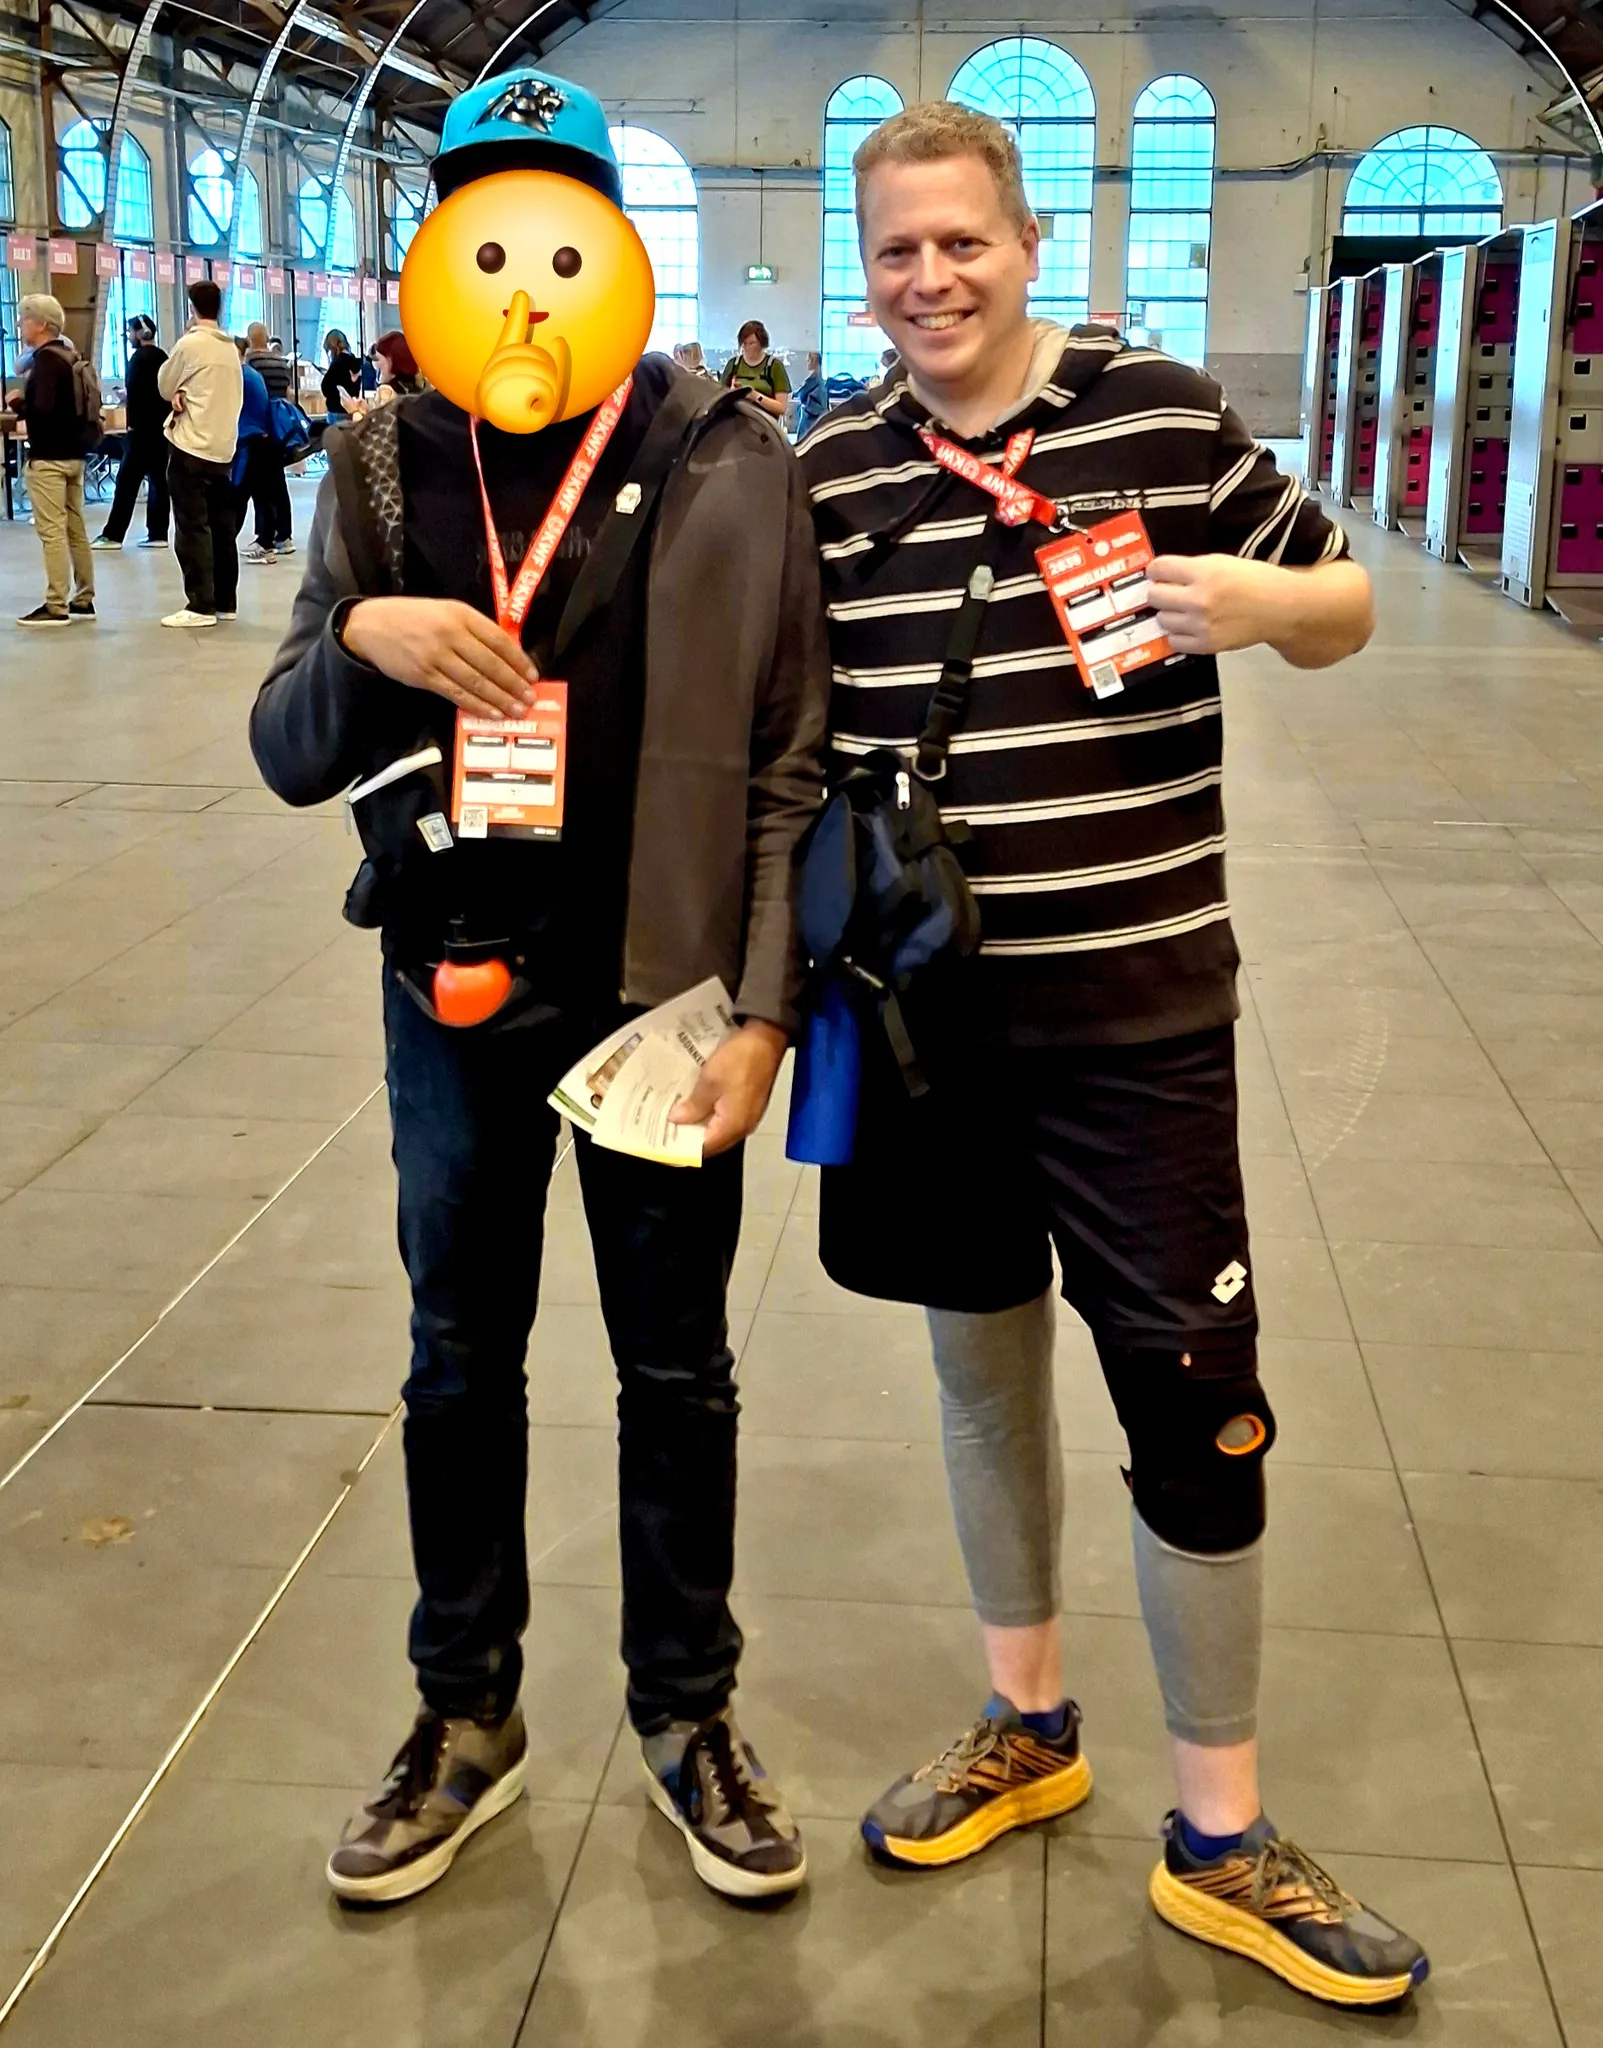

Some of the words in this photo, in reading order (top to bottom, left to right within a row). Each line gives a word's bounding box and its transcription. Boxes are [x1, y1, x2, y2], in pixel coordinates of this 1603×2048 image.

[586, 422, 611, 459] KWF
[937, 445, 967, 470] KWF
[559, 477, 585, 512] KWF
[981, 473, 1017, 500] KWF
[531, 530, 558, 566] KWF
[508, 580, 533, 623] KWF
